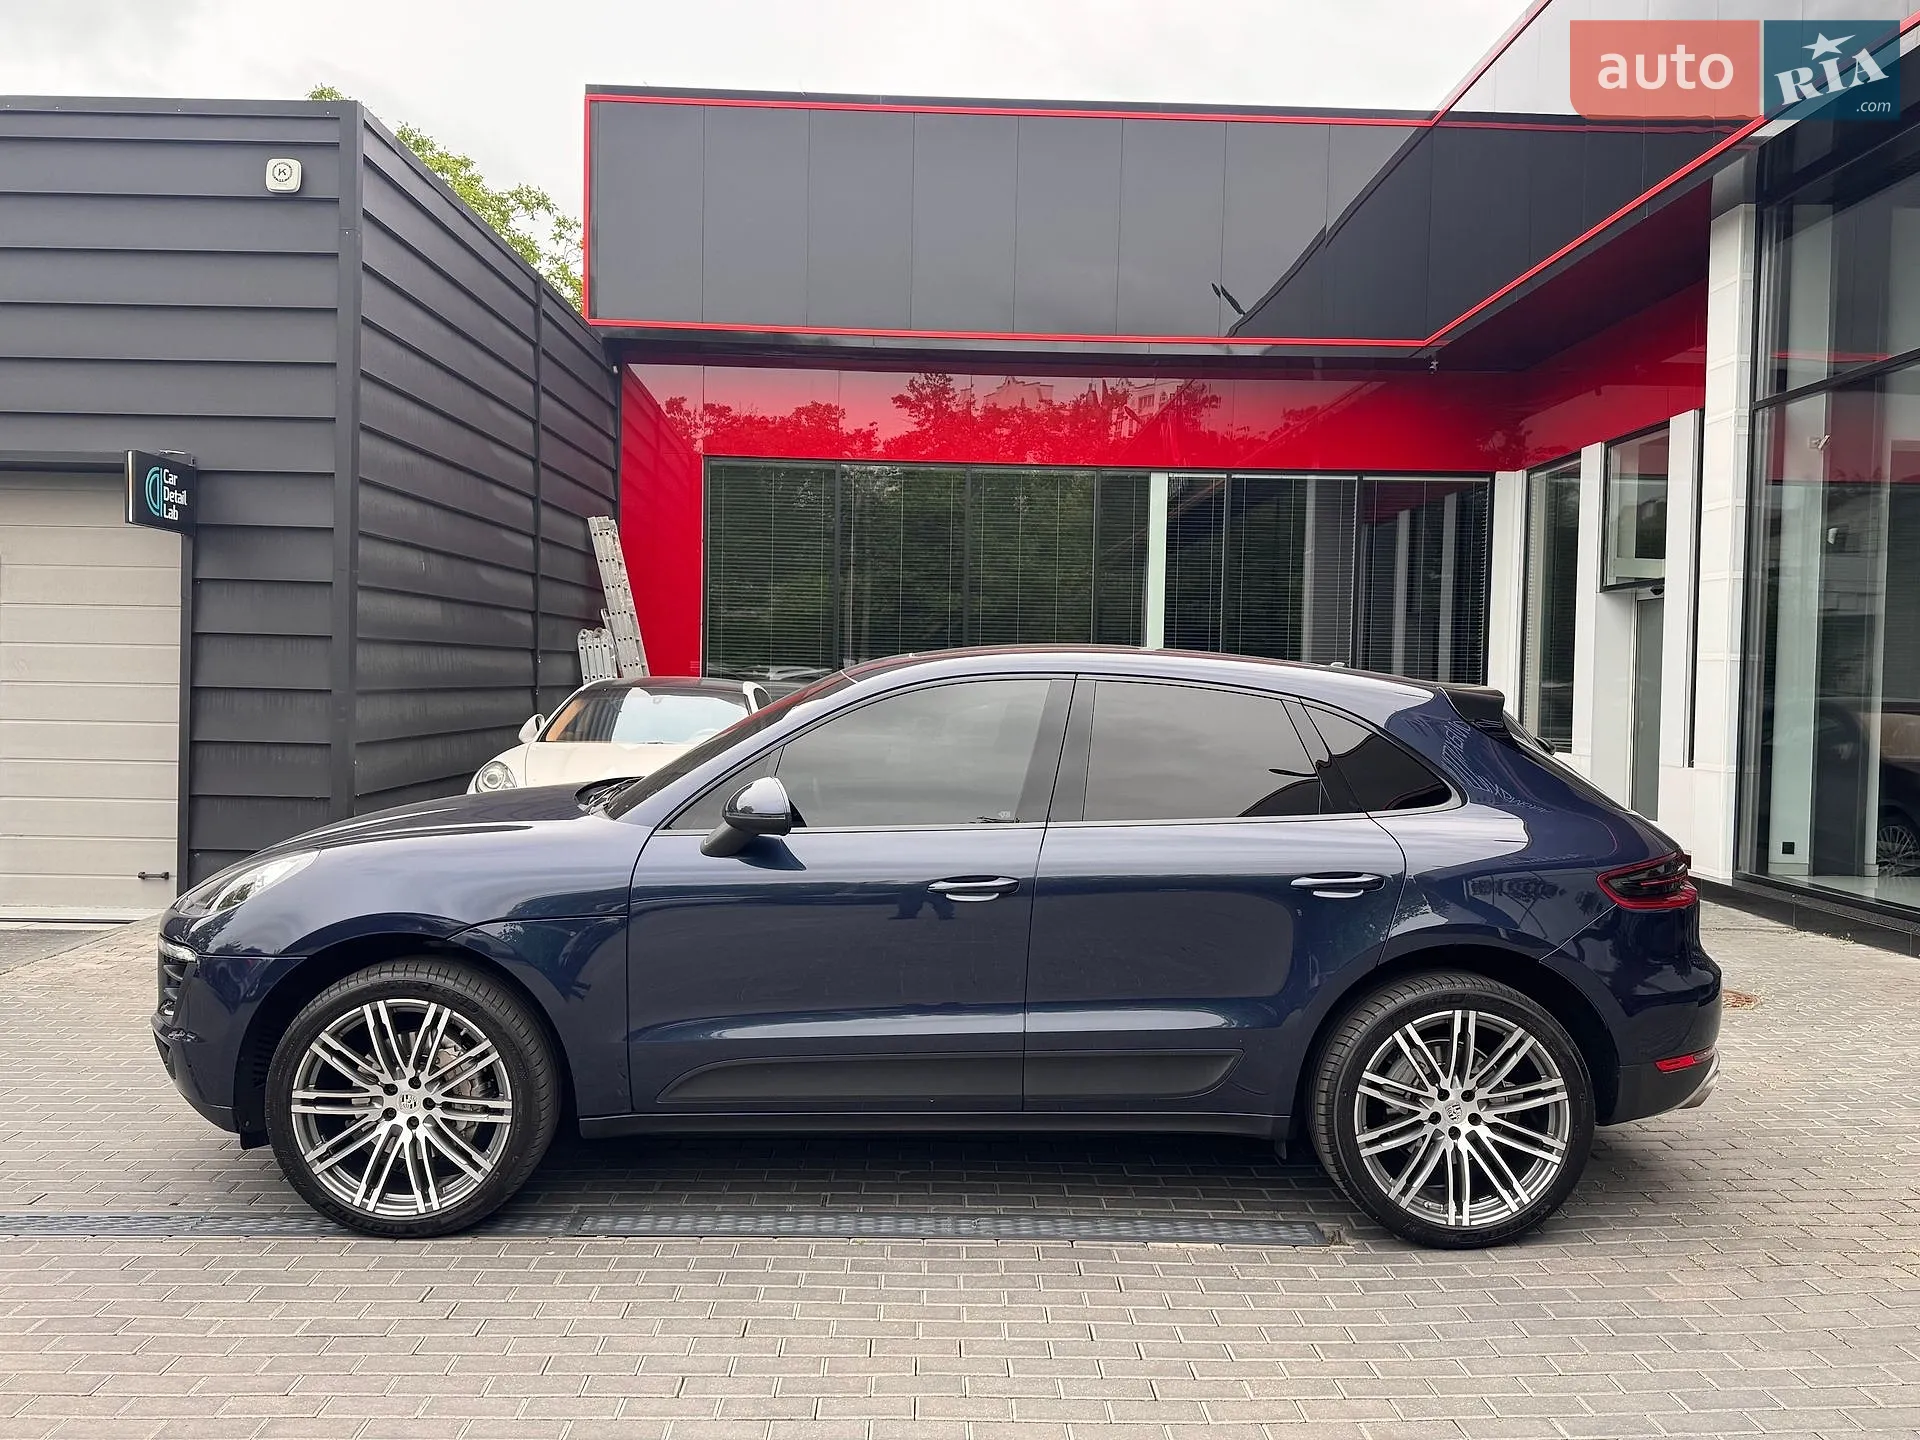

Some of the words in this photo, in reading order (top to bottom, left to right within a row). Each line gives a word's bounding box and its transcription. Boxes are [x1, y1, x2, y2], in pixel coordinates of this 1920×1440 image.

[163, 469, 178, 486] Car
[163, 486, 187, 505] Detail
[163, 503, 179, 520] Lab
